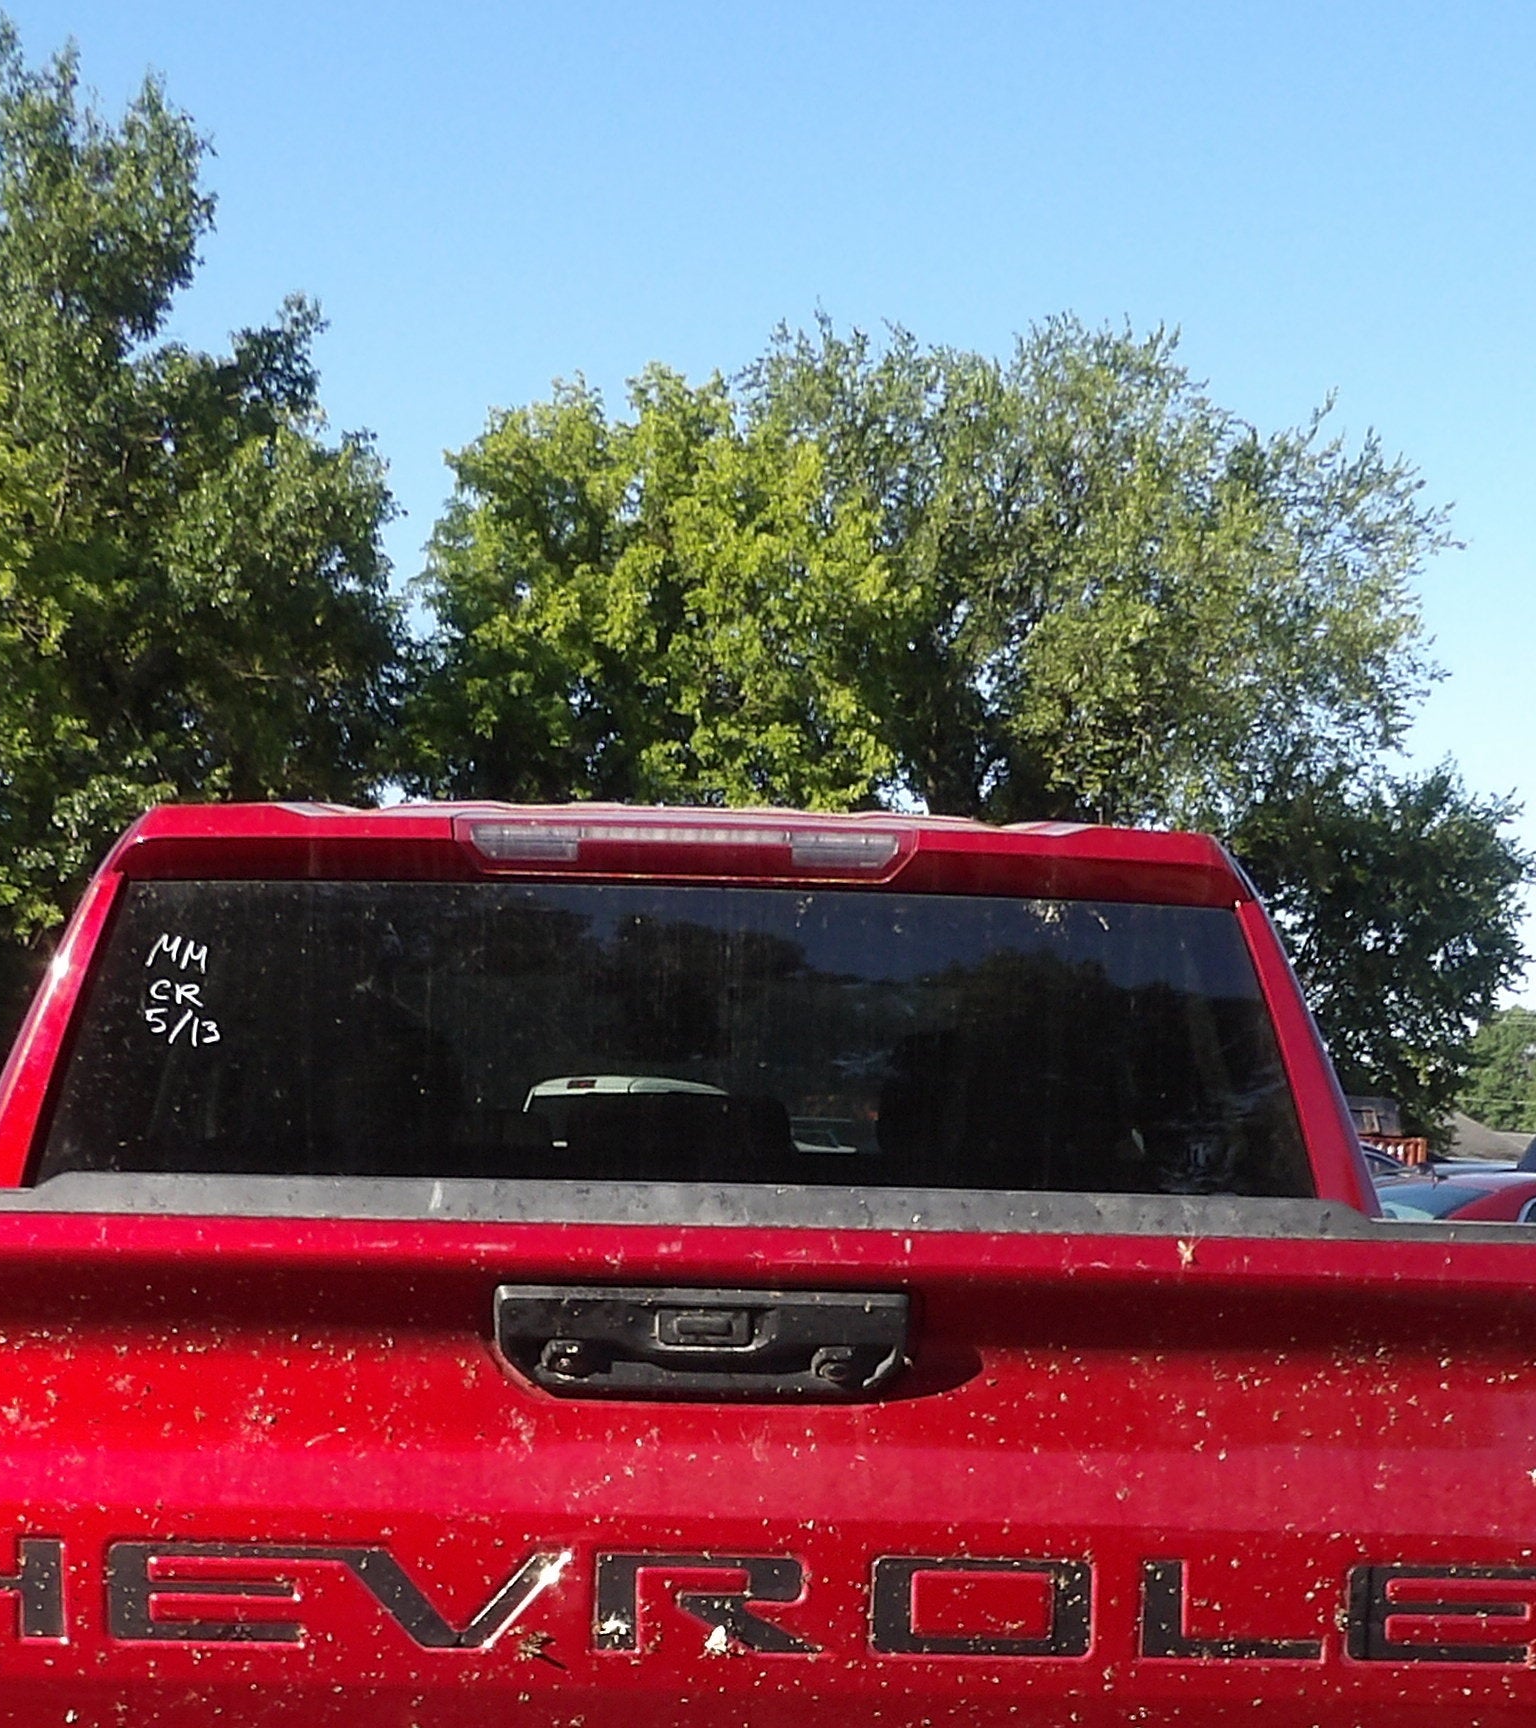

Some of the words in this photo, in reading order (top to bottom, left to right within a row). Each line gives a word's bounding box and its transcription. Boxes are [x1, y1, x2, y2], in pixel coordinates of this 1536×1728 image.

[145, 933, 207, 974] MM
[149, 979, 204, 1008] CR
[145, 1007, 221, 1047] 5/13
